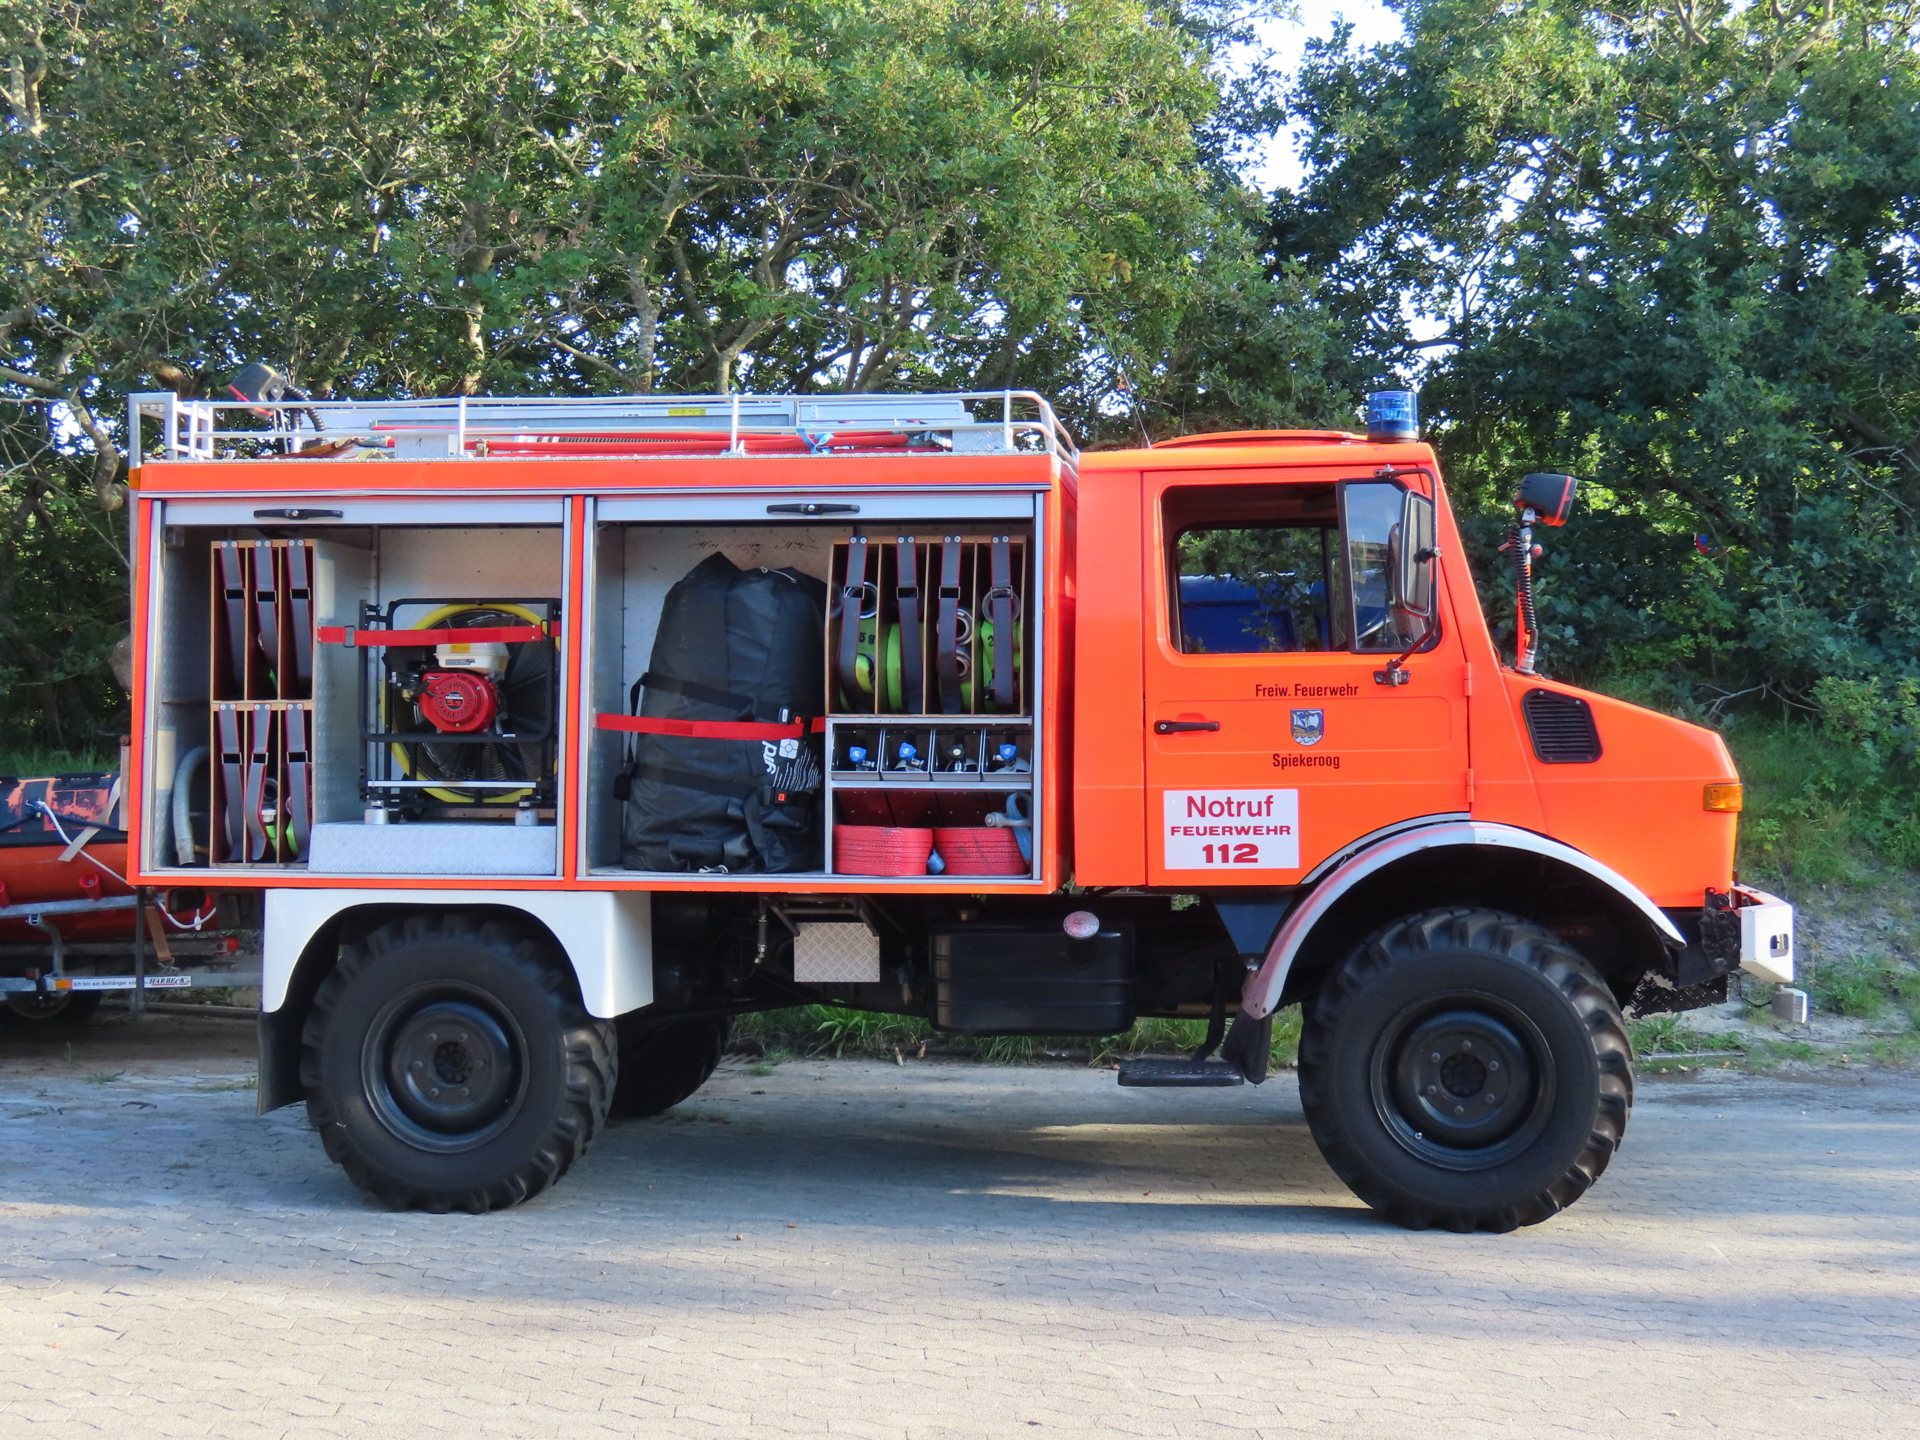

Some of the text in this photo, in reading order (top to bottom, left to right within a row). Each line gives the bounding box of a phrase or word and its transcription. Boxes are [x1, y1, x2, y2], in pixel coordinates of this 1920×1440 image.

[1255, 682, 1359, 697] Freiw. Feuerwehr
[1272, 753, 1340, 770] Spiekeroog
[1187, 794, 1274, 818] Notruf
[1170, 826, 1291, 836] FEUERWEHR
[1202, 843, 1259, 864] 112
